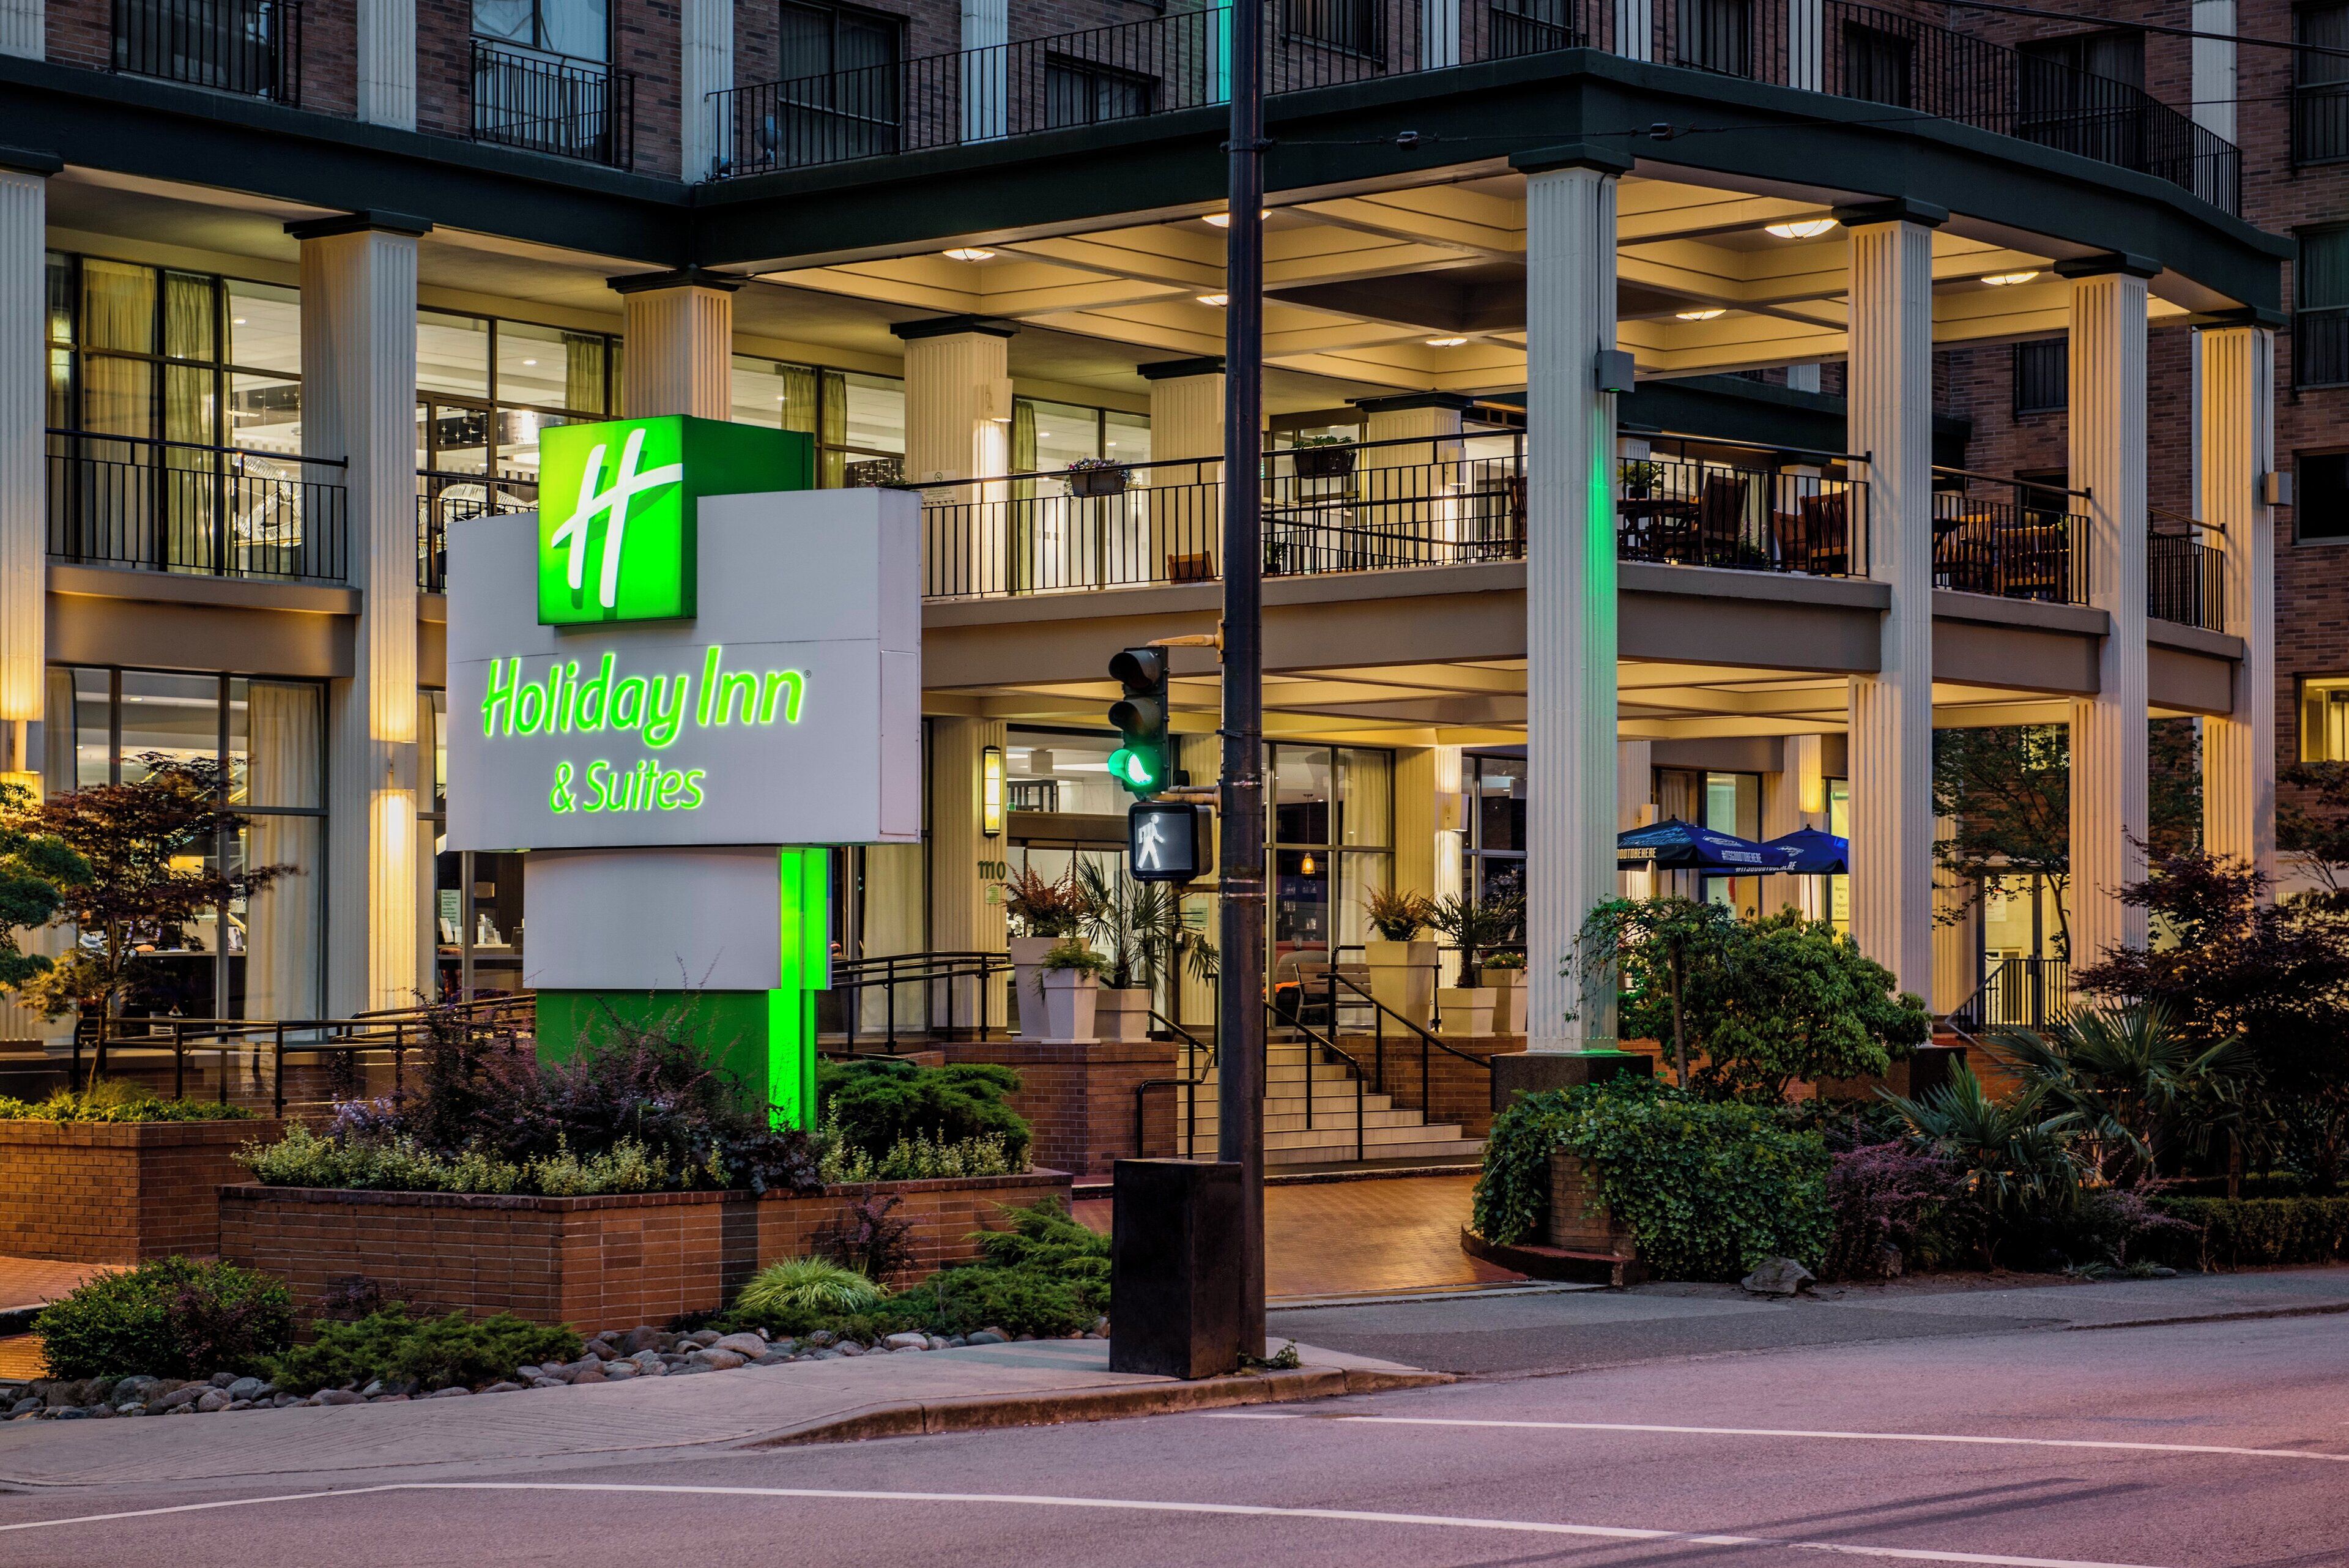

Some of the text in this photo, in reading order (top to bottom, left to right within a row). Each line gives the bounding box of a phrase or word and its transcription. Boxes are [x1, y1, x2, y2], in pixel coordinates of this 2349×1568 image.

[481, 645, 806, 750] Holiday Inn
[549, 760, 707, 814] & Suites
[978, 861, 1006, 880] 1110
